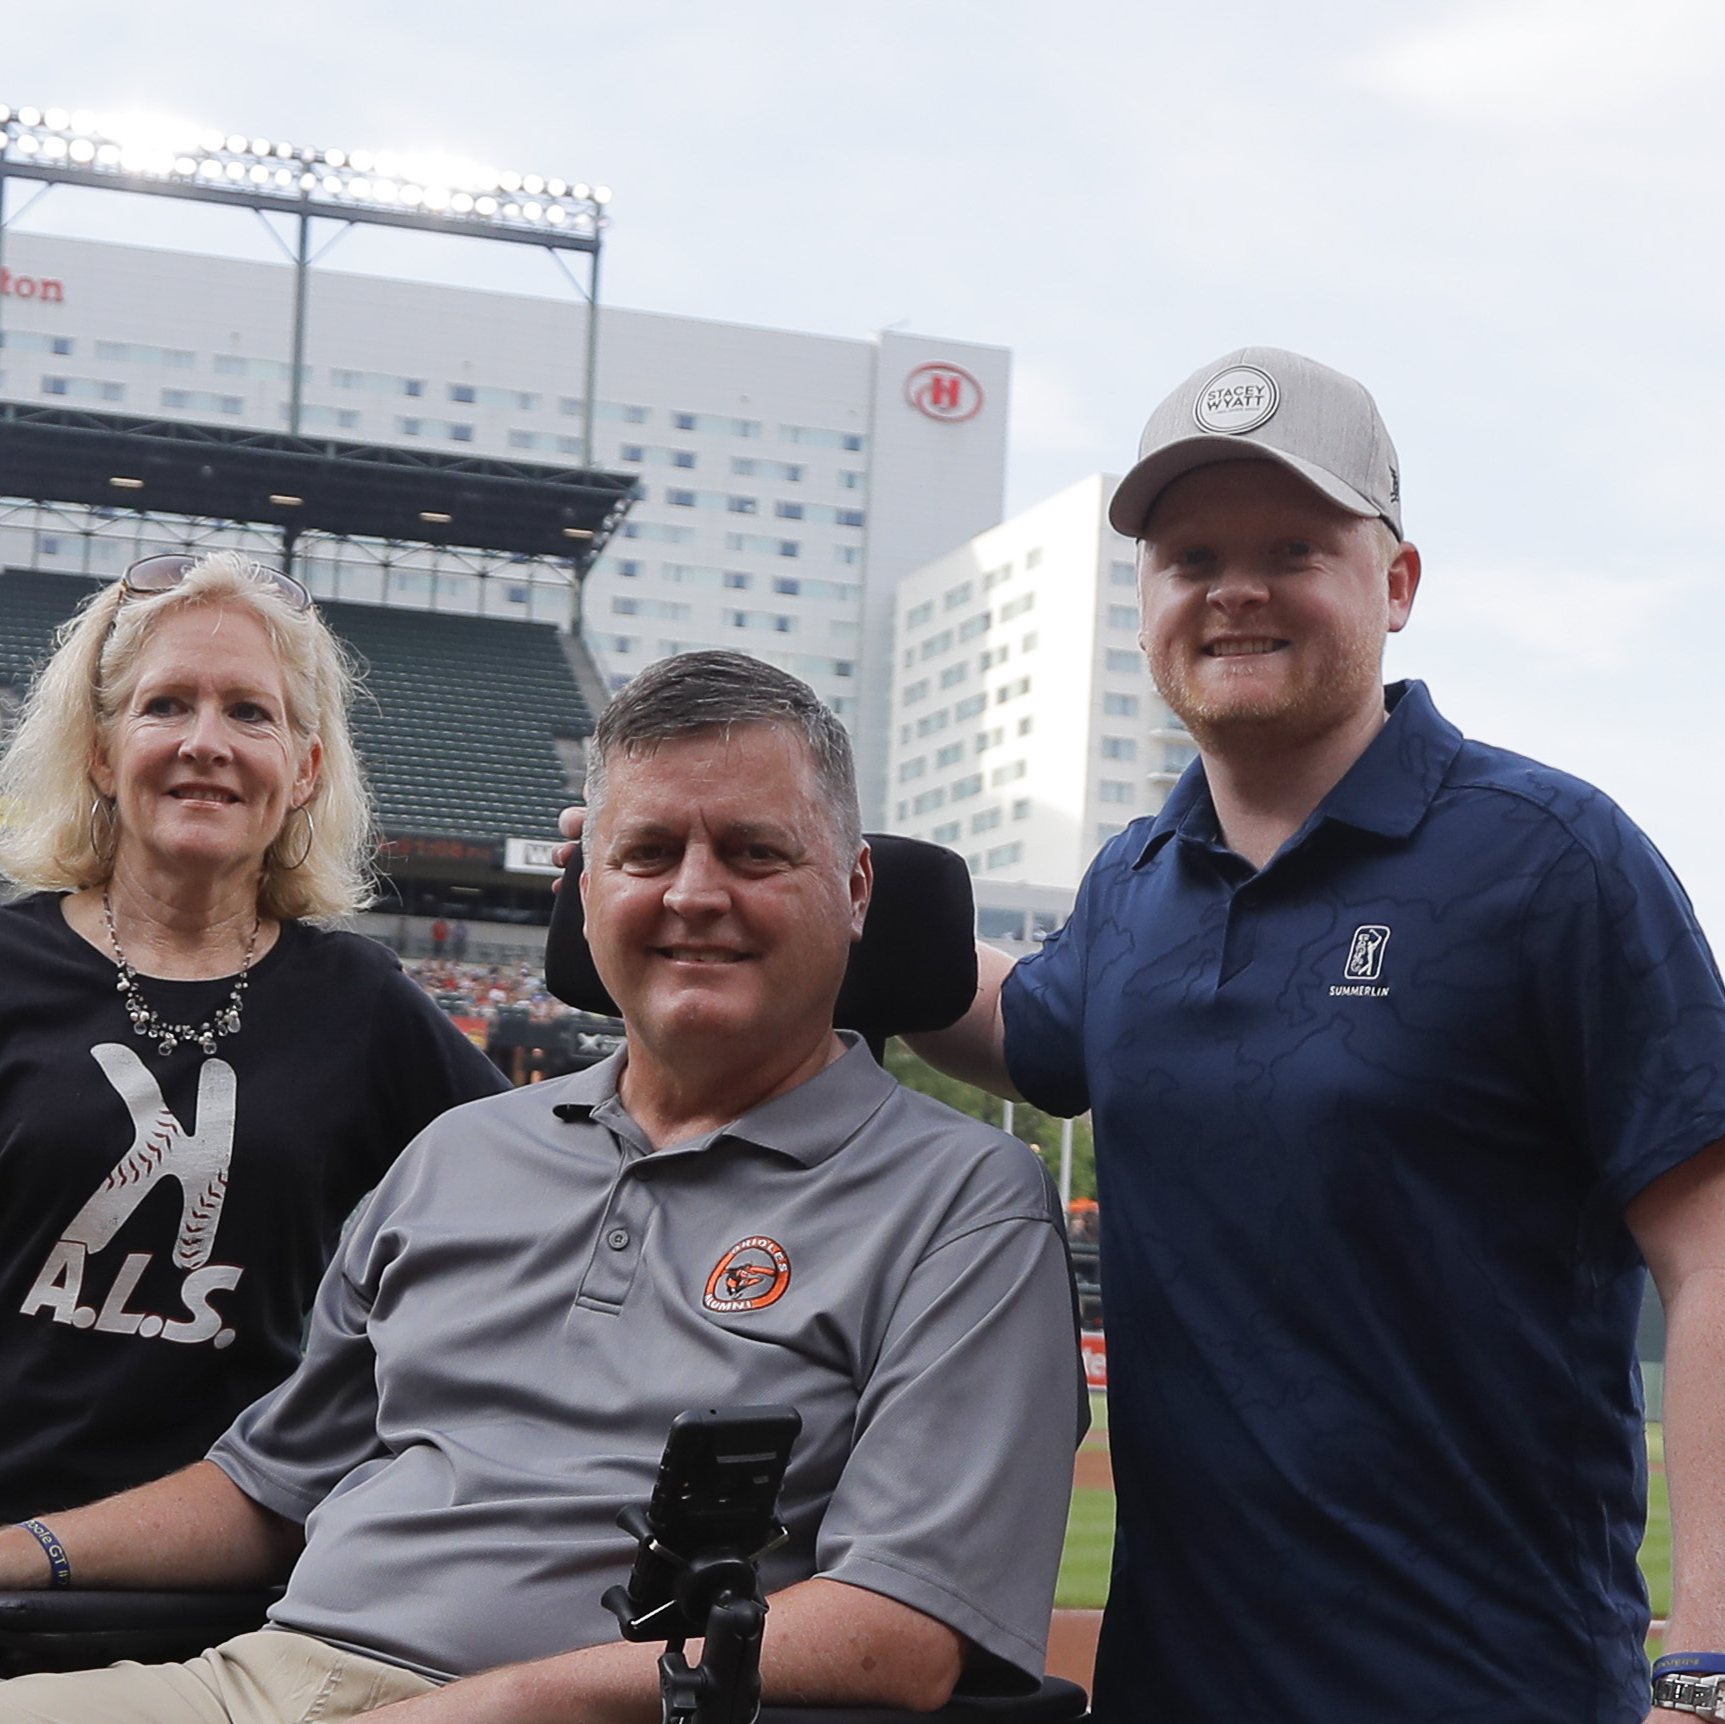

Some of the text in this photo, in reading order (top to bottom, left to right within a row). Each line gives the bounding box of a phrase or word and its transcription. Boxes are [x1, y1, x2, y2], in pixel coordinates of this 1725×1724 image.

[1207, 384, 1266, 401] STACEY
[1207, 395, 1264, 411] WYATT
[1328, 985, 1390, 997] SUMMERLIN
[731, 1238, 789, 1273] ORIOLES
[19, 1240, 244, 1350] A.L.S.
[704, 1293, 753, 1311] ALUMNI
[49, 1544, 67, 1565] GT
